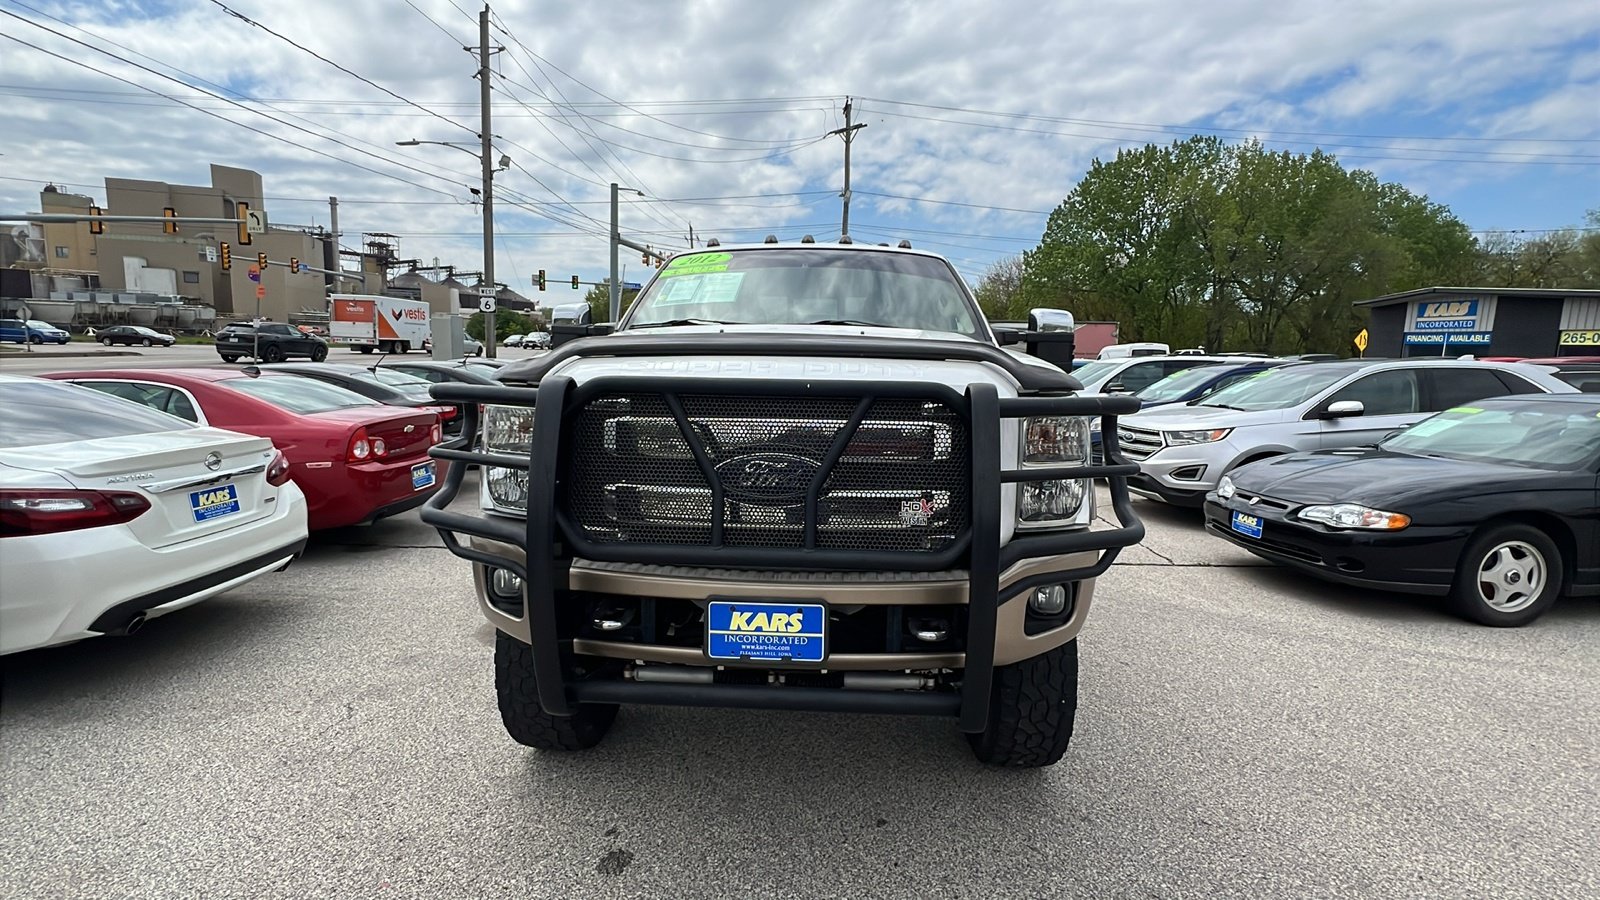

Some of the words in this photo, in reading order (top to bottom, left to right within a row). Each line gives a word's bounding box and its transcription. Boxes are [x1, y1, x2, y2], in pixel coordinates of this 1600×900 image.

[485, 301, 491, 310] 6
[1424, 302, 1471, 317] KARS
[404, 308, 426, 321] vestis
[1417, 320, 1473, 328] INCORPORATED
[107, 473, 155, 484] ALTIMA
[199, 489, 230, 507] KARS
[199, 501, 235, 513] INCORPORATED
[1238, 513, 1257, 526] KARS
[729, 612, 803, 632] KARS
[724, 635, 808, 645] INCORPORATED
